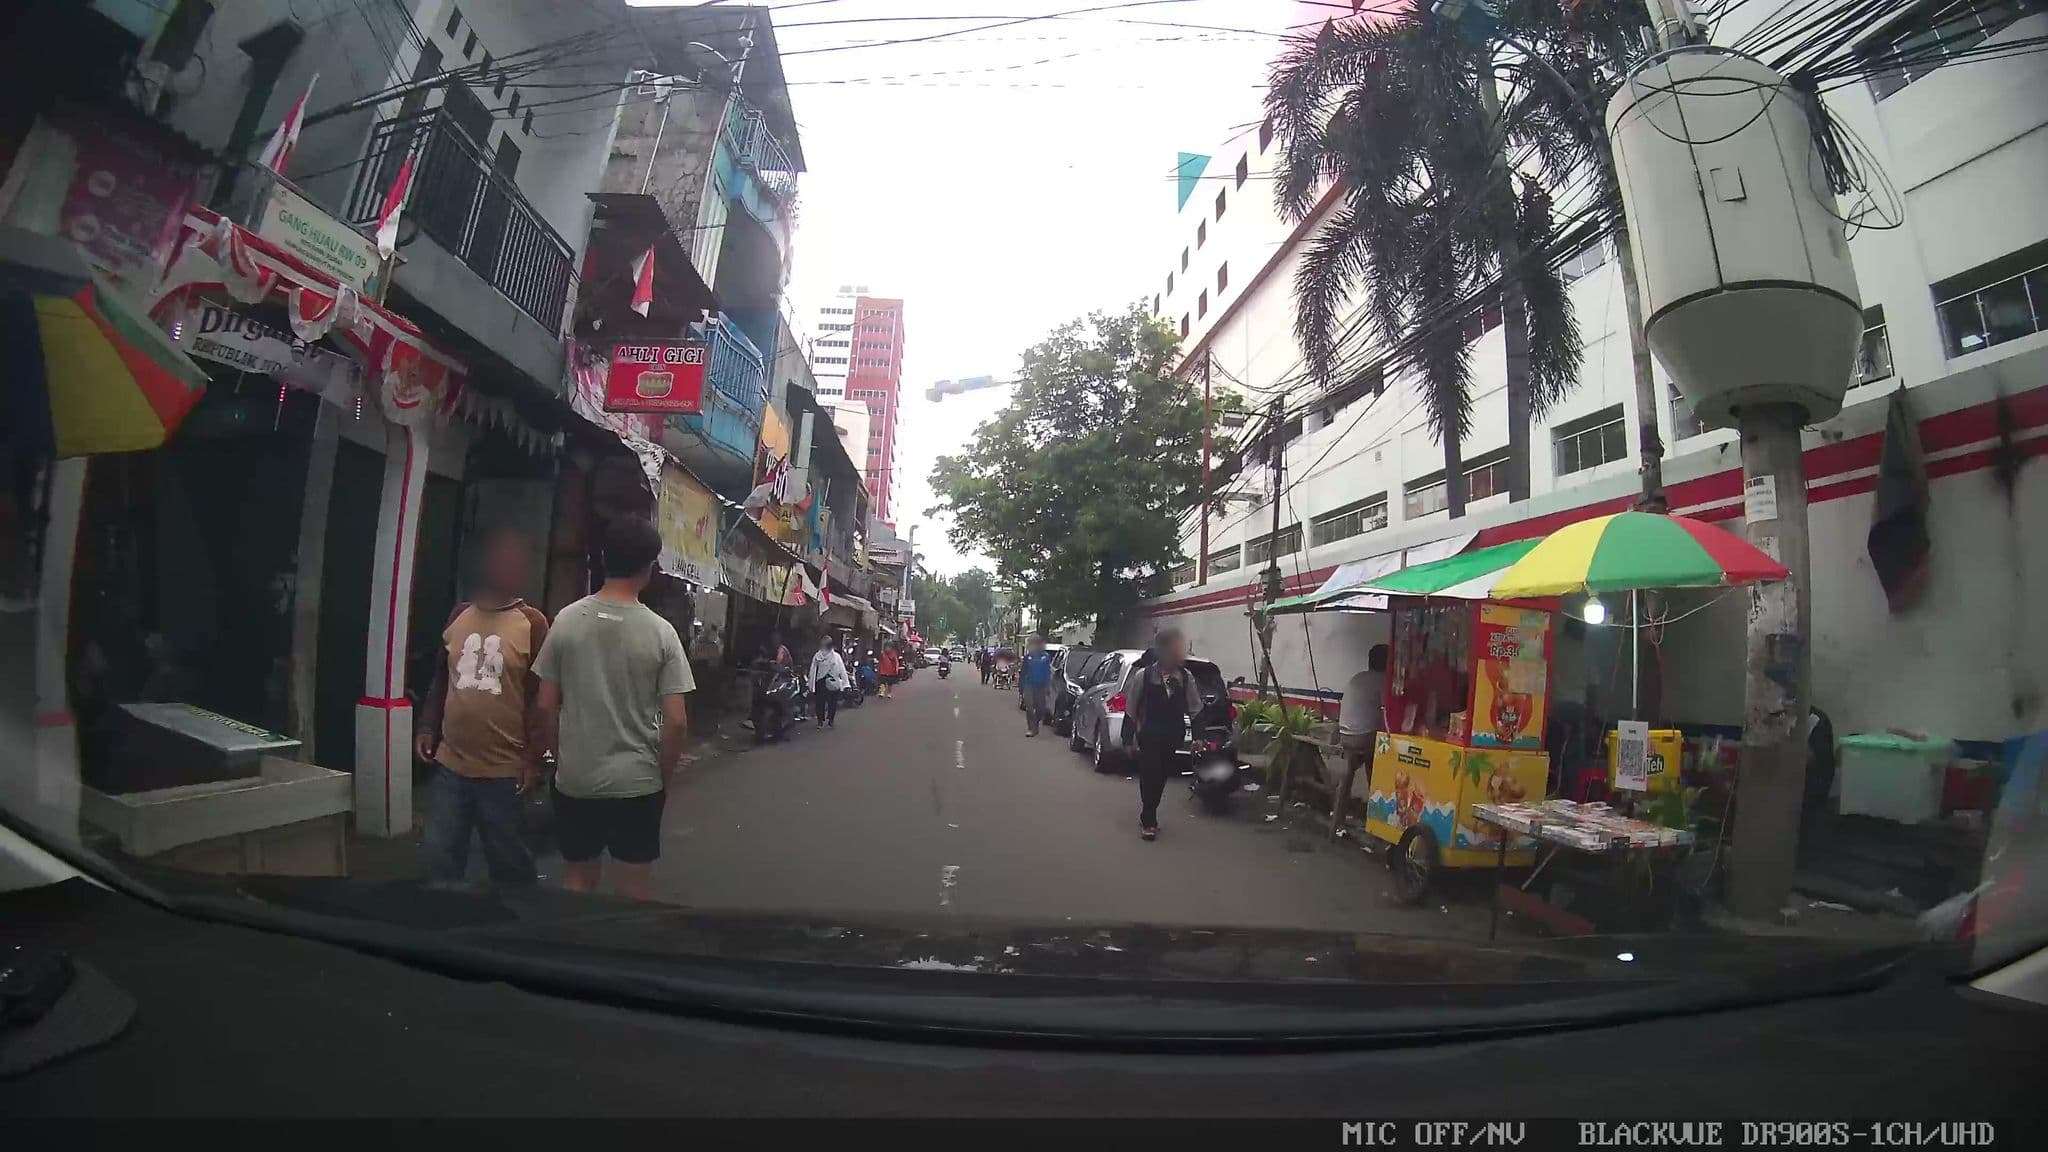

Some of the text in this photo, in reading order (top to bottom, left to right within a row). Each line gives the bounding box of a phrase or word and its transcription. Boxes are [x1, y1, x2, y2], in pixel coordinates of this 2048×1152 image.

[278, 209, 308, 236] GANG
[354, 255, 367, 269] 09
[191, 336, 260, 369] REPUBLIK
[617, 346, 705, 364] AHLI GIGI
